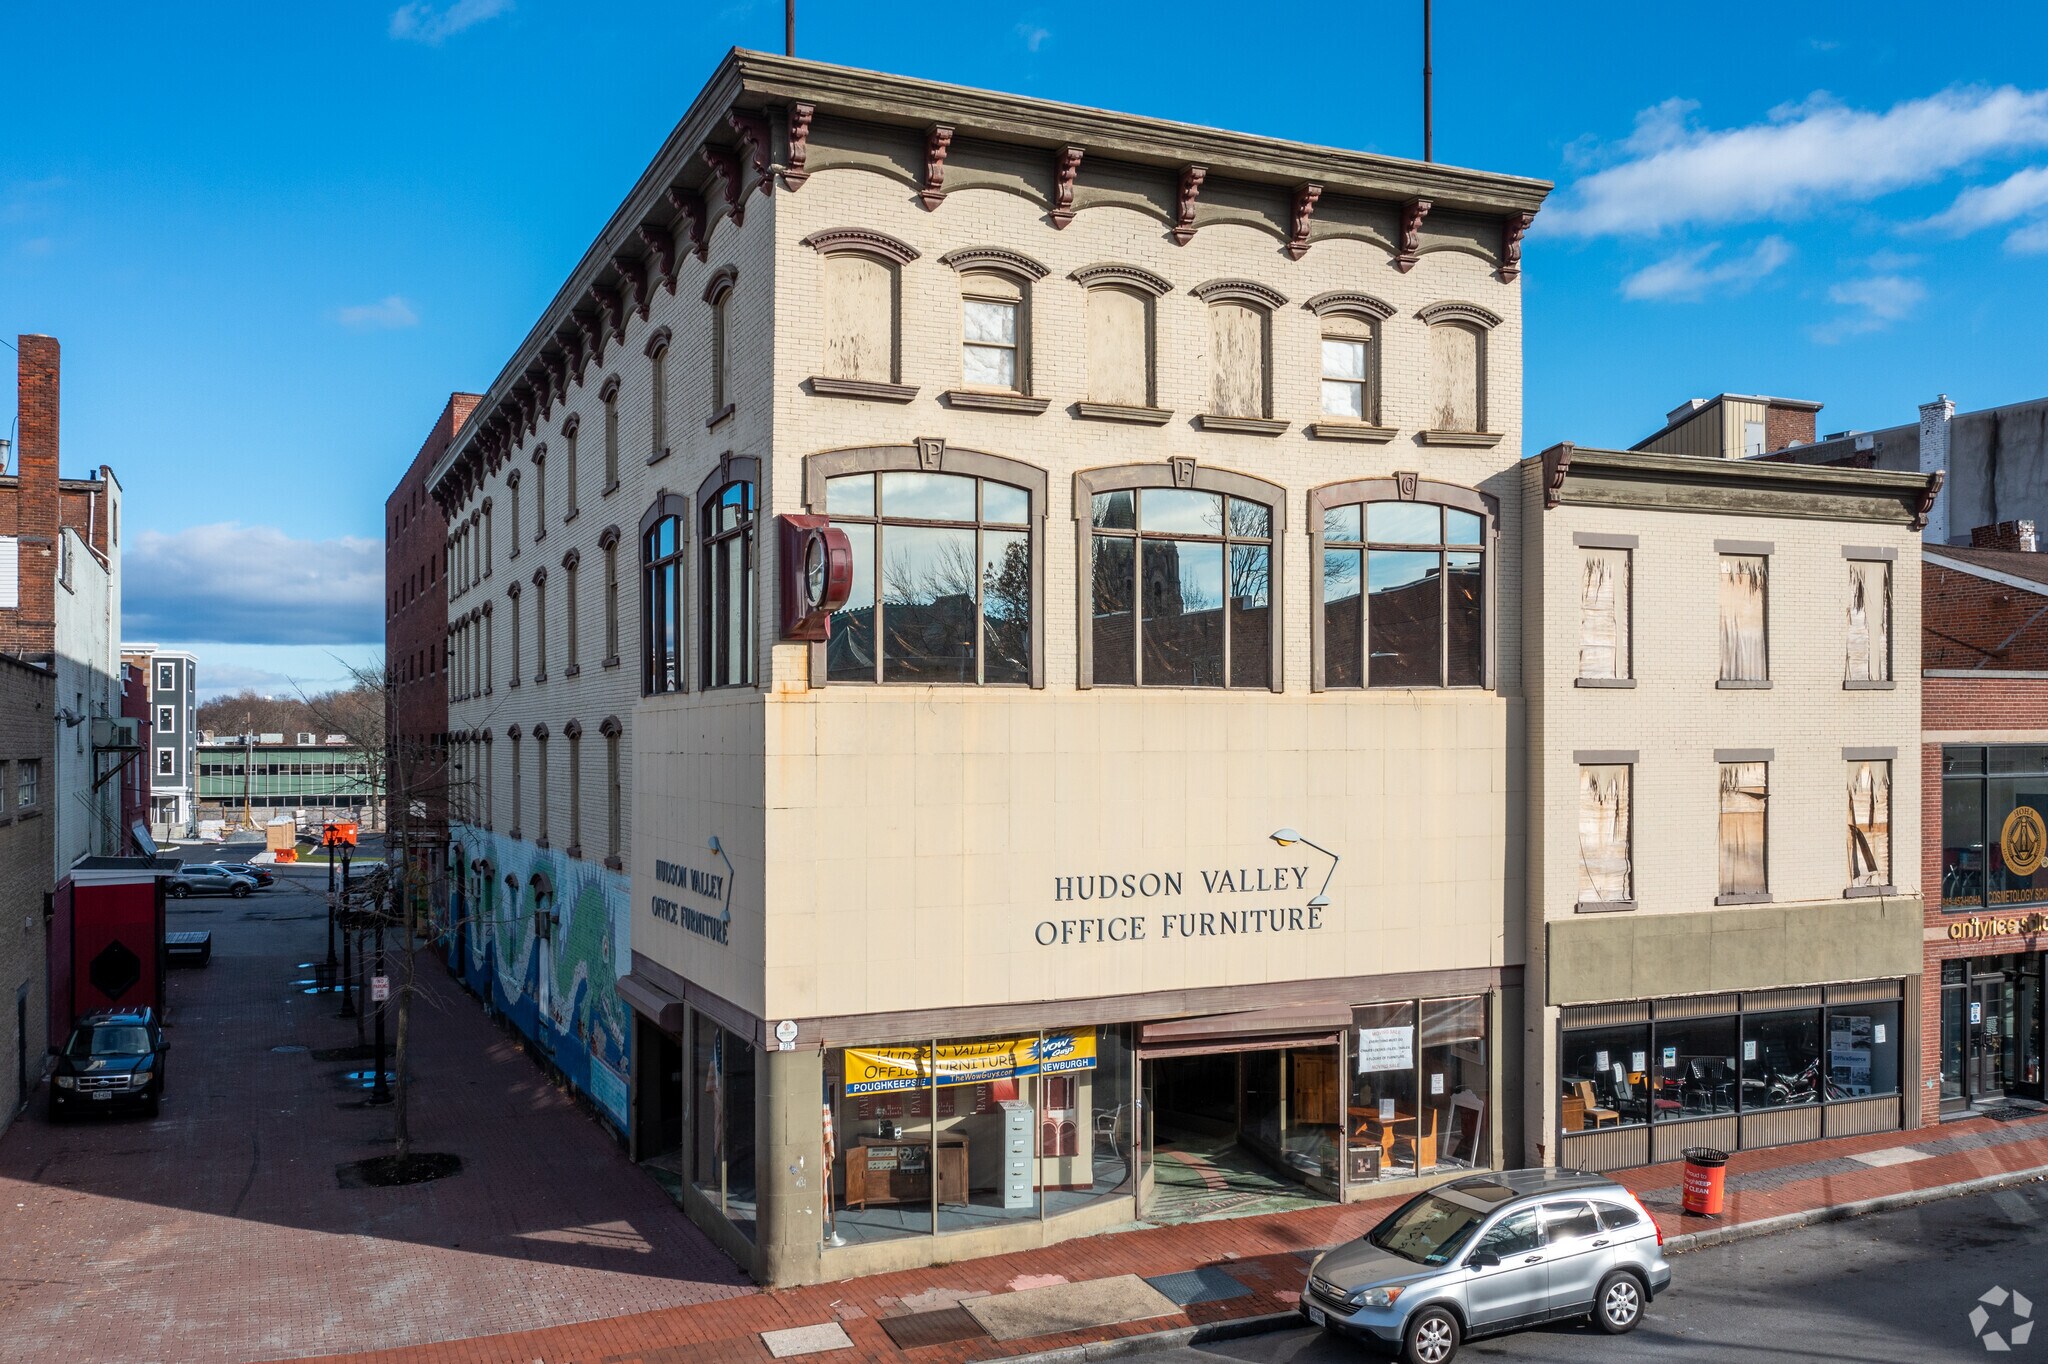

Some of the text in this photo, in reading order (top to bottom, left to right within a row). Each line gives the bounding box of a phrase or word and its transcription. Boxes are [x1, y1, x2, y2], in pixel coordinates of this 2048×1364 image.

[656, 859, 723, 900] HUDSON VALLEY
[1054, 866, 1309, 901] HUDSON VALLEY
[1988, 889, 2033, 904] COSMETOLOGY
[652, 896, 729, 945] OFFICE FURNITURE
[1035, 907, 1323, 946] OFFICE FURNITURE
[878, 1043, 1006, 1063] HUDSON VALLEY
[1052, 1046, 1074, 1057] Guys
[934, 1053, 1017, 1071] URNITURE
[1042, 1059, 1089, 1072] NEWBURGH
[853, 1069, 1015, 1092] POUGHKEEPSIE TheWowGuys.com
[1689, 1185, 1709, 1195] CLEAN
